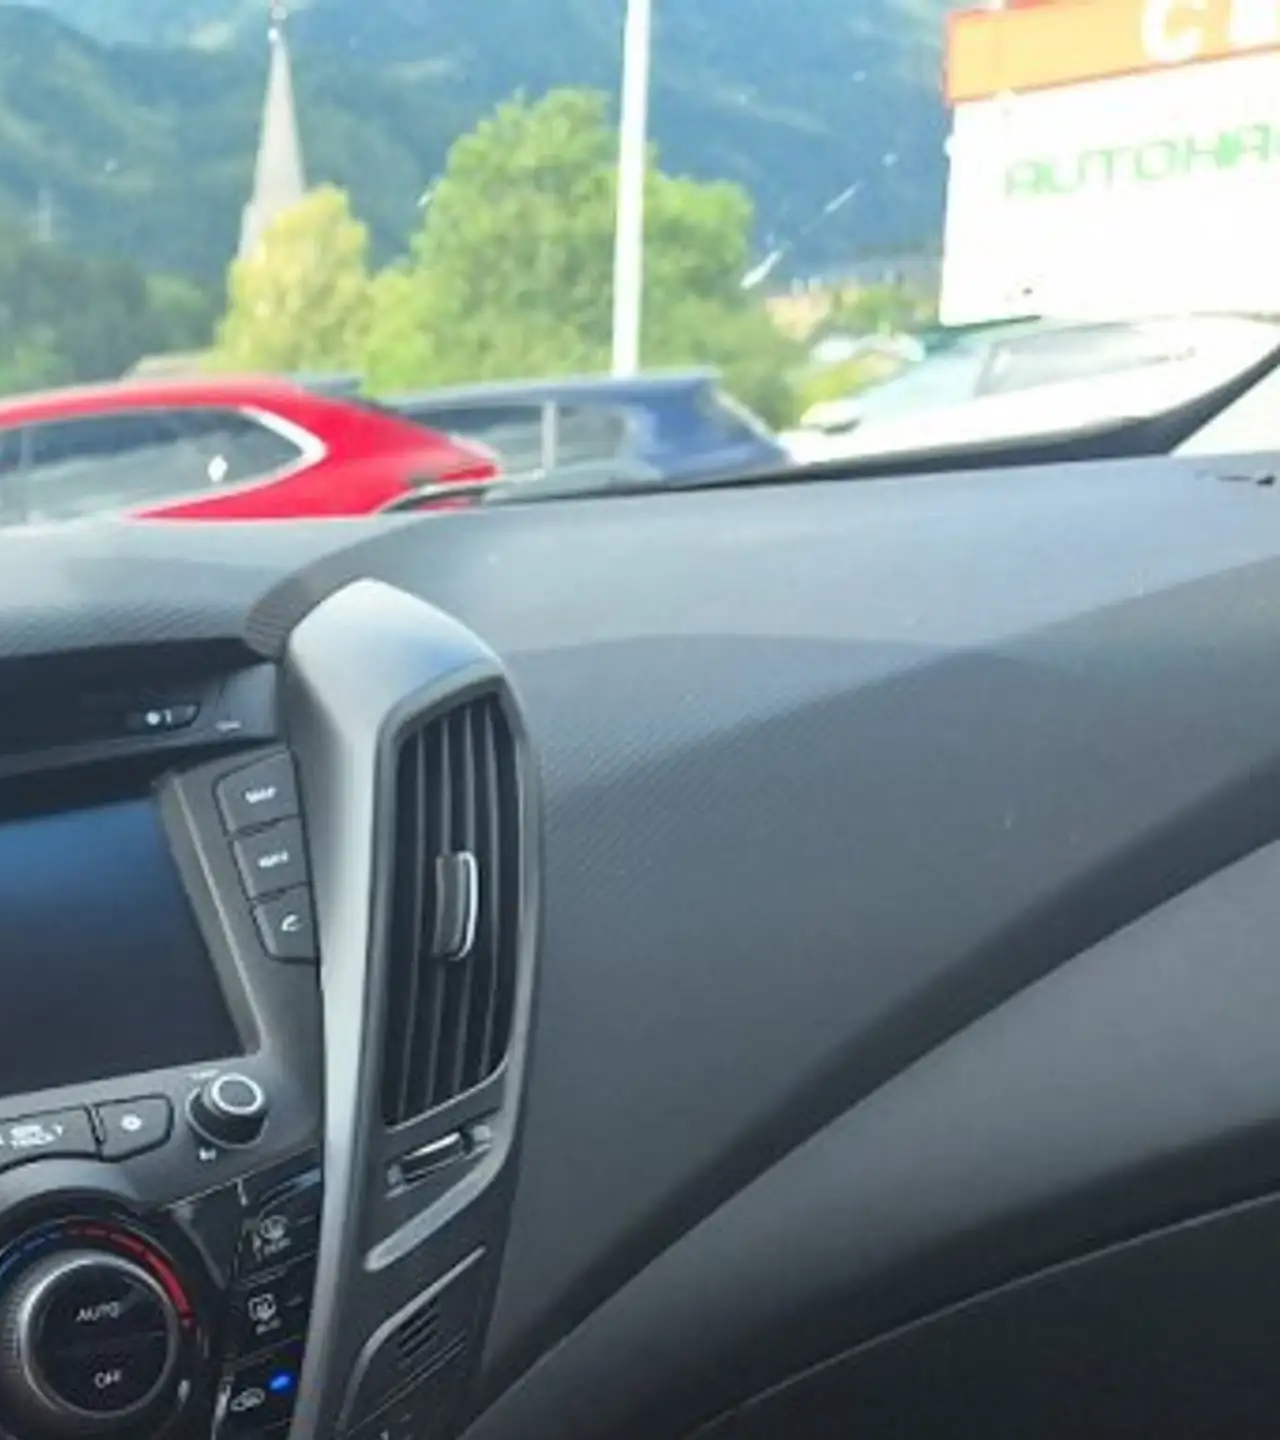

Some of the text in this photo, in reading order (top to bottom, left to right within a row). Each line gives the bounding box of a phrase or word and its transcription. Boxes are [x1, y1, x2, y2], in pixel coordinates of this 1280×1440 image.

[1003, 122, 1280, 201] AUTOHA
[75, 1301, 121, 1324] AUTO
[94, 1369, 122, 1389] OFF
